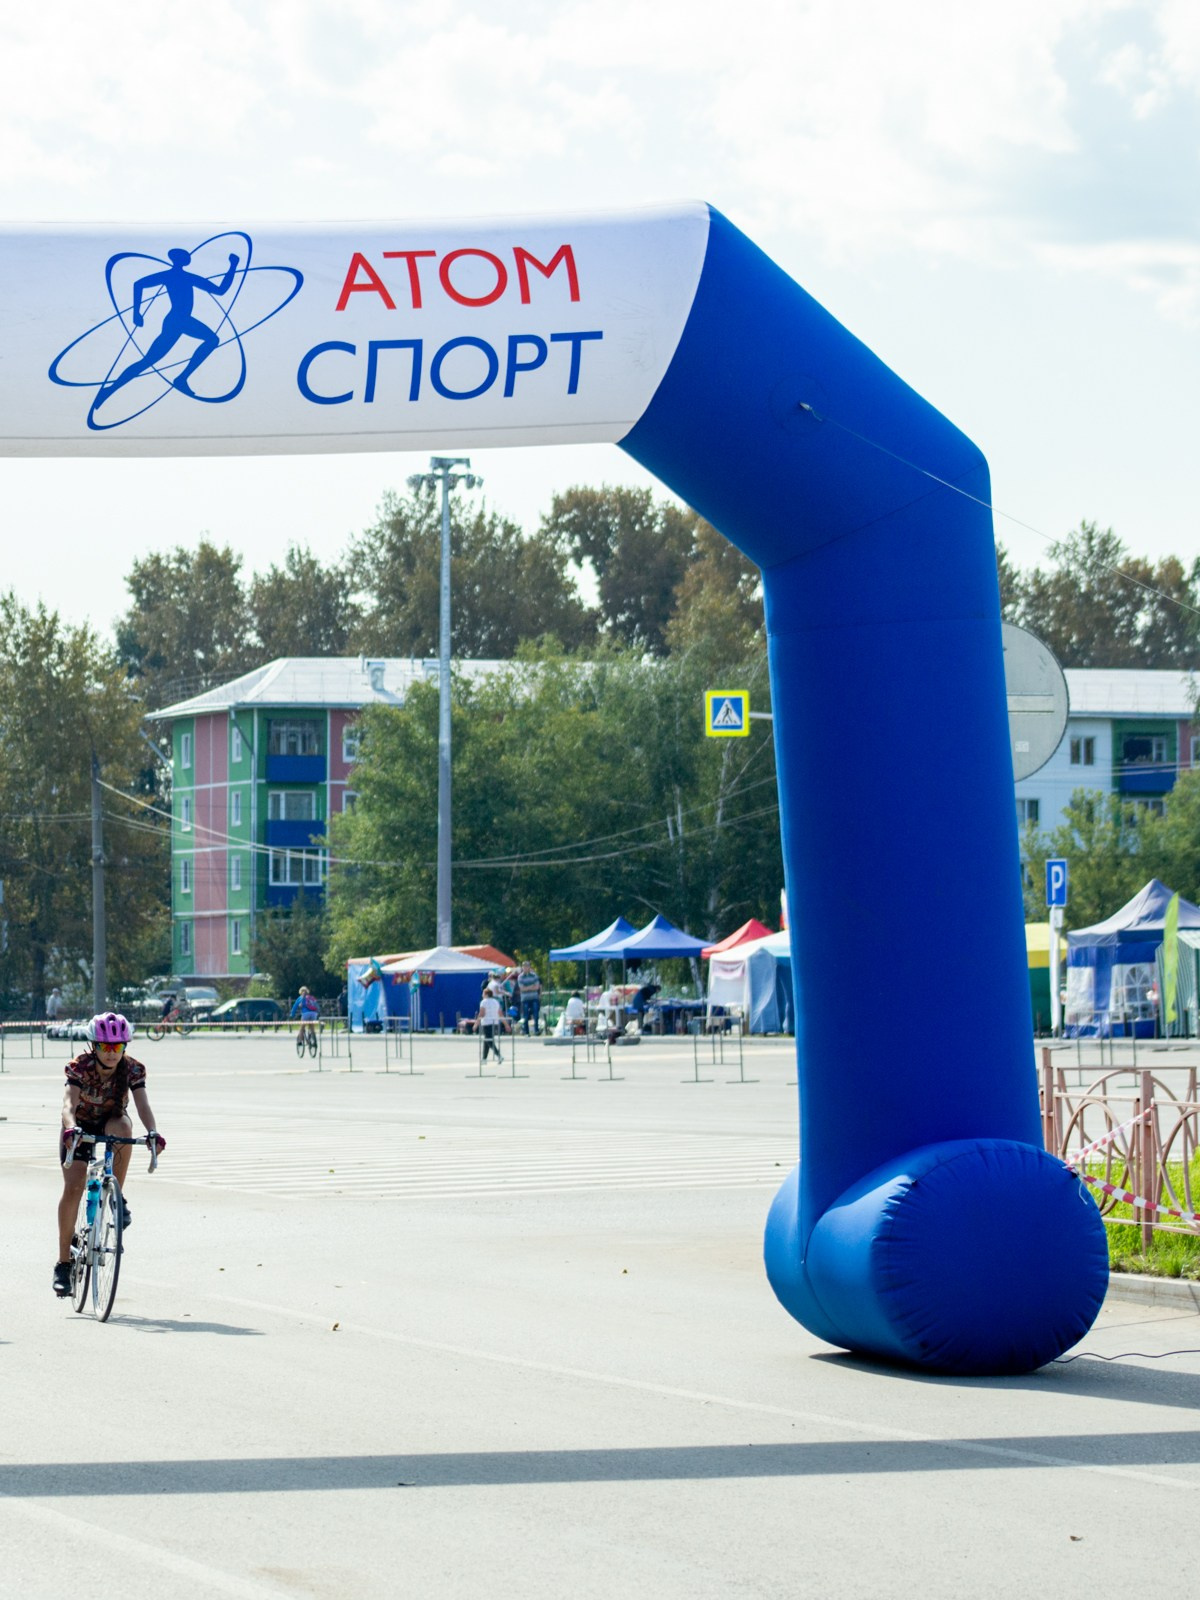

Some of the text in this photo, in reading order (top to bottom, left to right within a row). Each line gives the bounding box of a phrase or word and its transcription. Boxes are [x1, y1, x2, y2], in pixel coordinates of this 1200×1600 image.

[335, 244, 581, 311] АТОМ
[297, 330, 603, 405] СПОРТ
[1051, 865, 1064, 901] P
